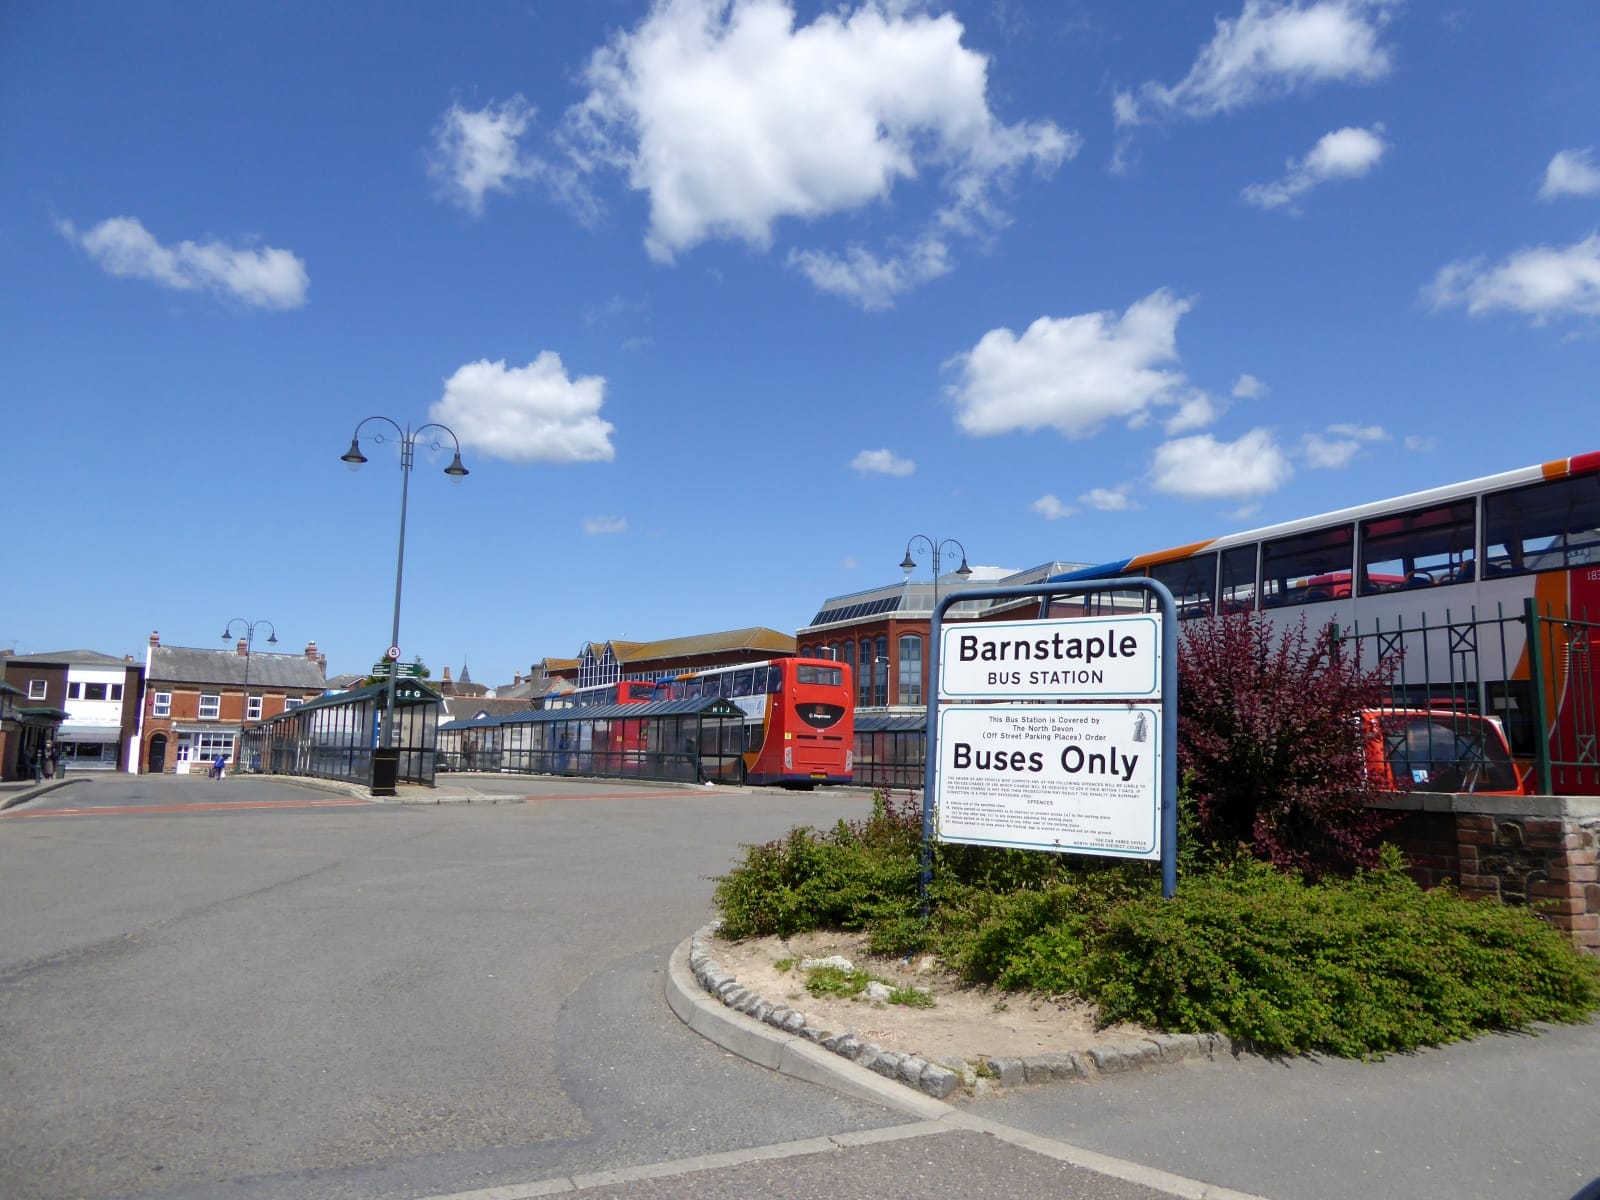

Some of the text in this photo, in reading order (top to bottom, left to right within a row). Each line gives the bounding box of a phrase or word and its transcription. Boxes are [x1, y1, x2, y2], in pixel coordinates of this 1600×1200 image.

[960, 630, 1138, 664] Barnstaple
[988, 670, 1104, 685] BUS STATION
[1025, 733, 1051, 741] Parking
[1055, 733, 1082, 741] Places)
[954, 742, 1139, 782] Buses Only
